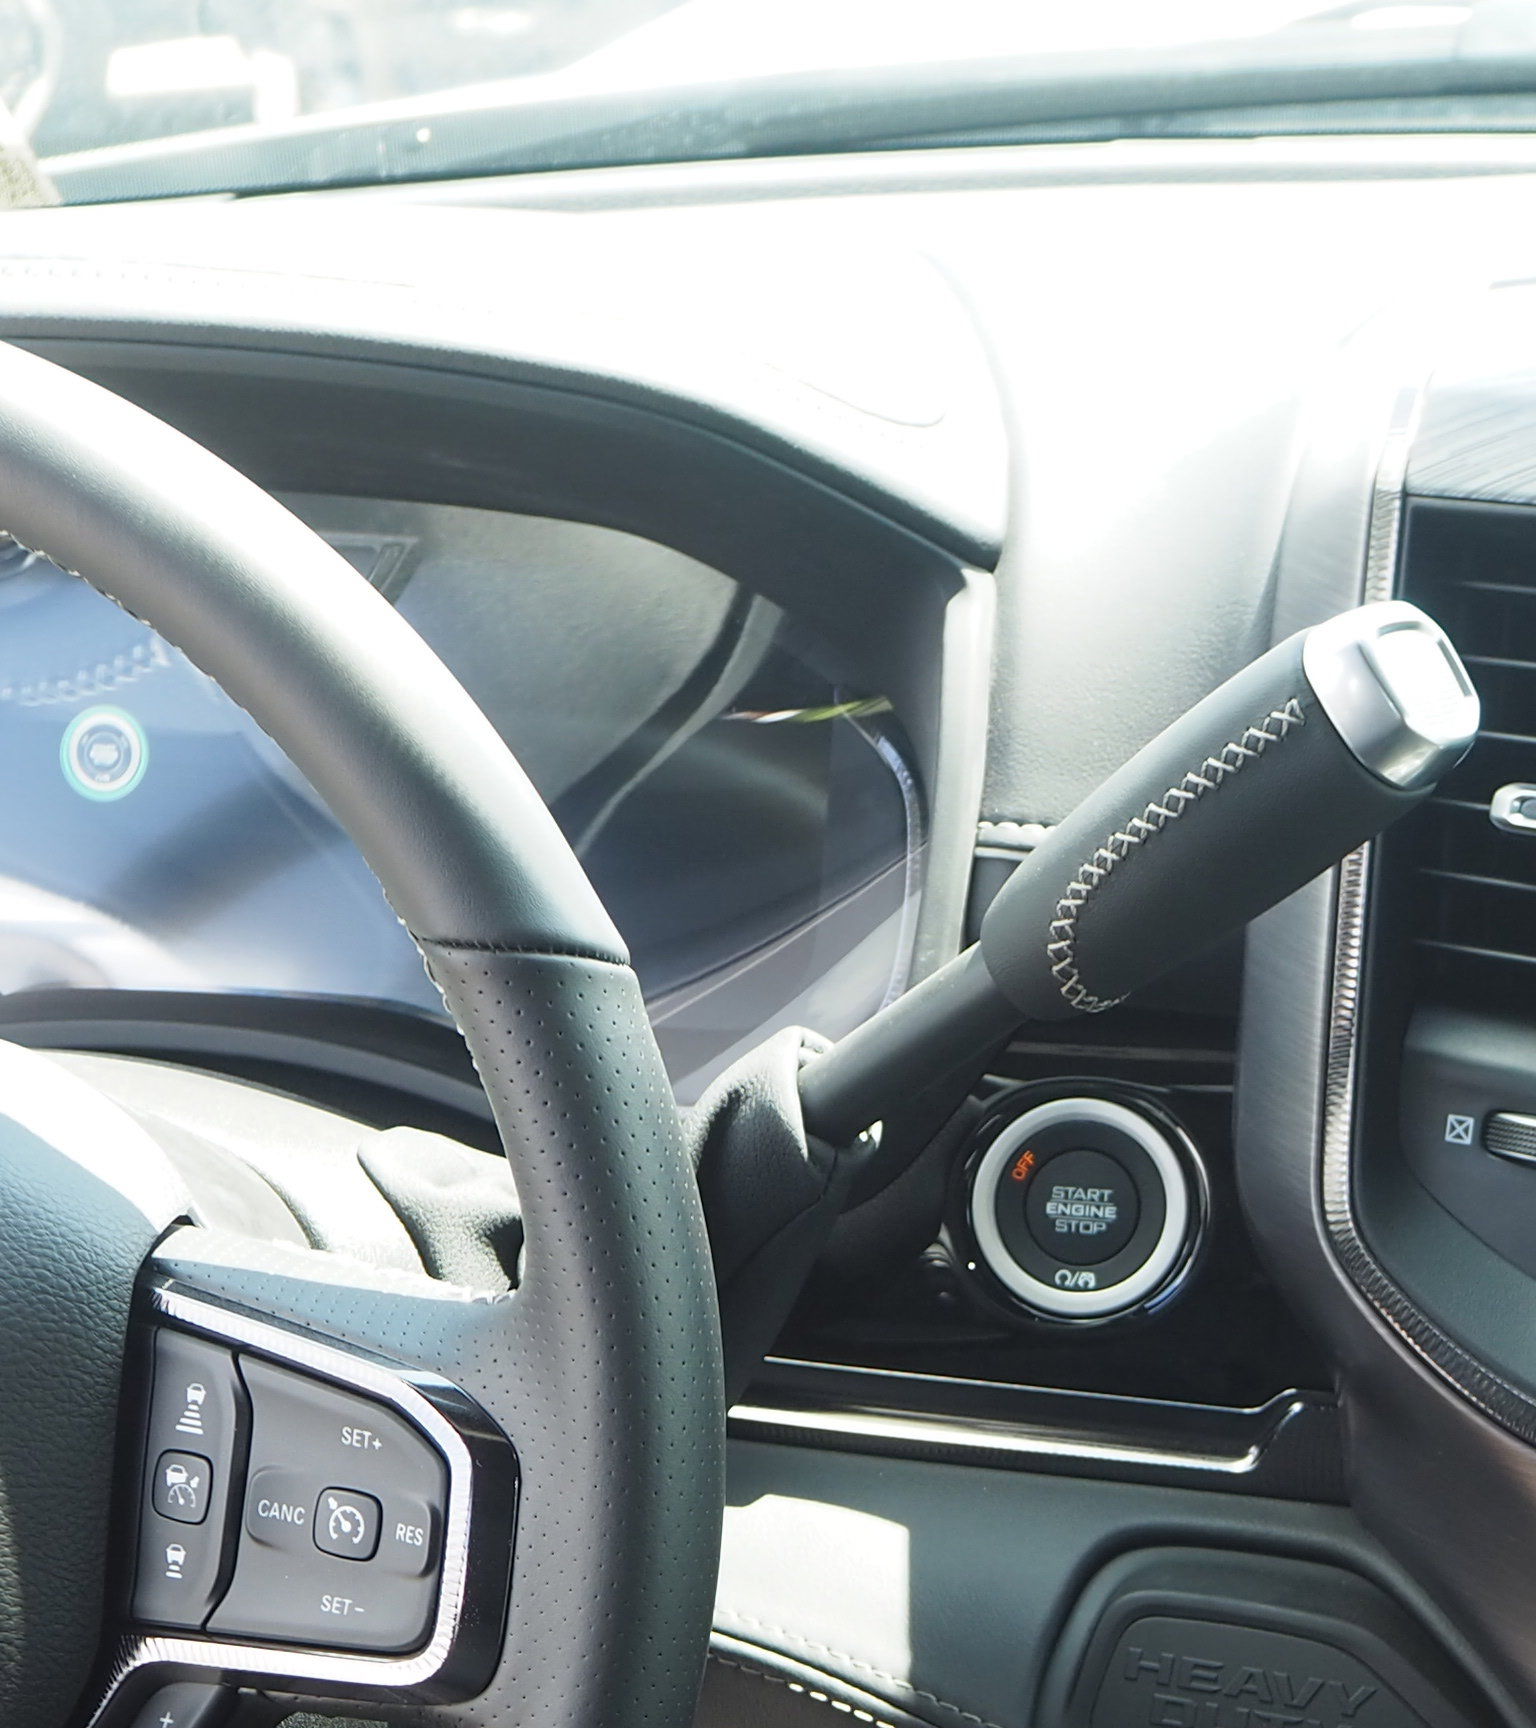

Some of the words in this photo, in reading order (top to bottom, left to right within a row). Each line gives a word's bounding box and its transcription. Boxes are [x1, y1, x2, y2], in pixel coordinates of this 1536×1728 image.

[1012, 1150, 1036, 1182] OFF
[1052, 1186, 1112, 1201] START
[1045, 1202, 1117, 1218] ENGINE
[1055, 1219, 1107, 1234] STOP
[257, 1499, 305, 1526] CANC
[395, 1523, 424, 1547] RES
[1124, 1647, 1377, 1718] HEAVY
